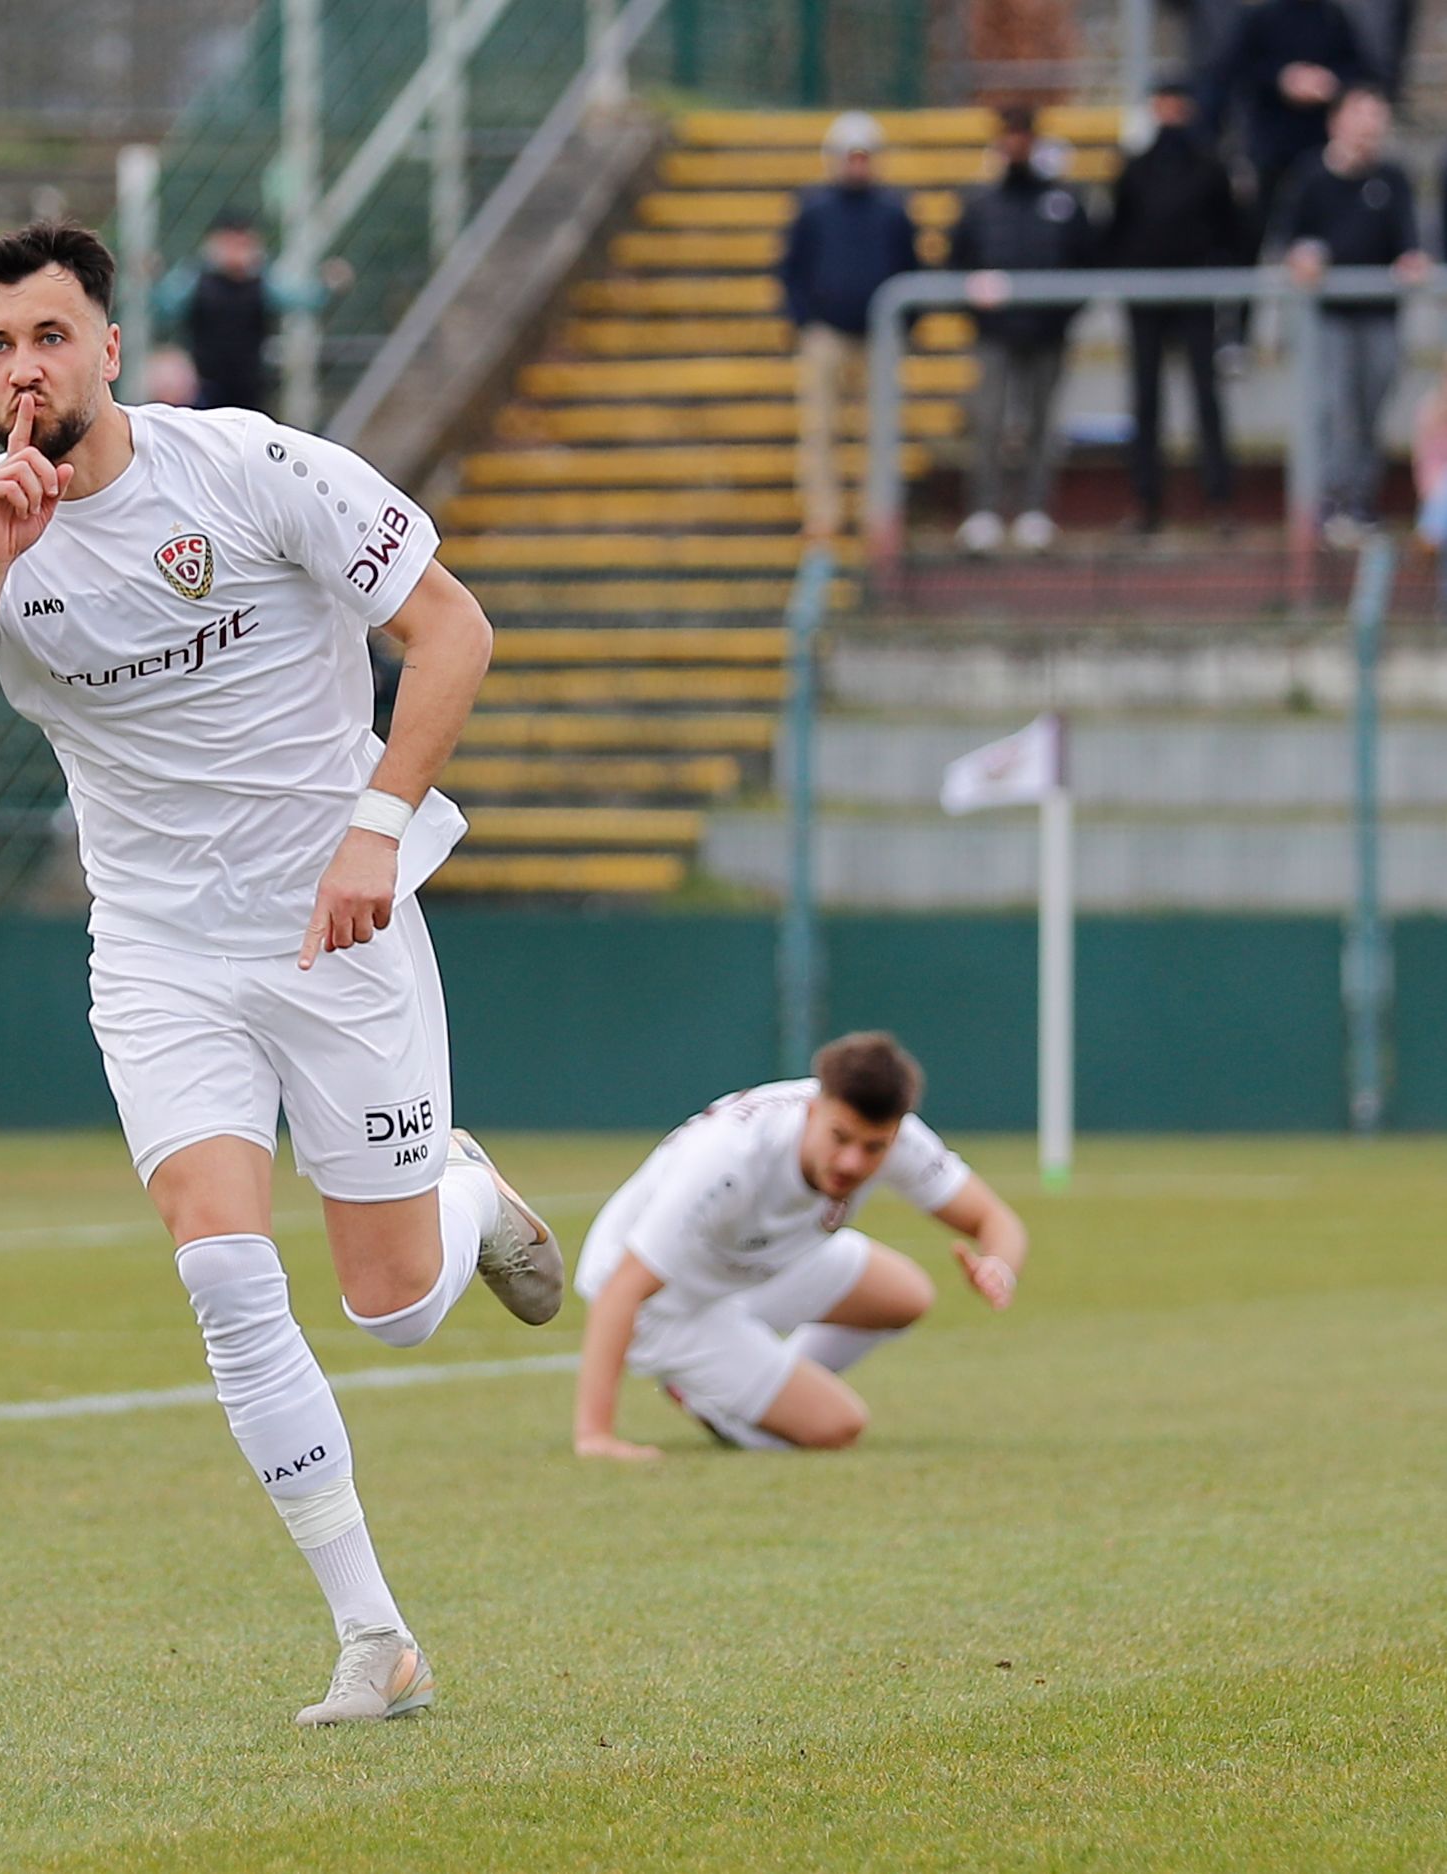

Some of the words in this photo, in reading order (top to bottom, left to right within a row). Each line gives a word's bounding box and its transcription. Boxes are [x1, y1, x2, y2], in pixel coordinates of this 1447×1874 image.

[160, 538, 204, 565] BFC
[346, 506, 409, 593] DWB
[23, 598, 65, 617] JAKO
[365, 1100, 434, 1142] DWB
[394, 1144, 429, 1167] JAKO
[262, 1445, 327, 1484] JAKO
